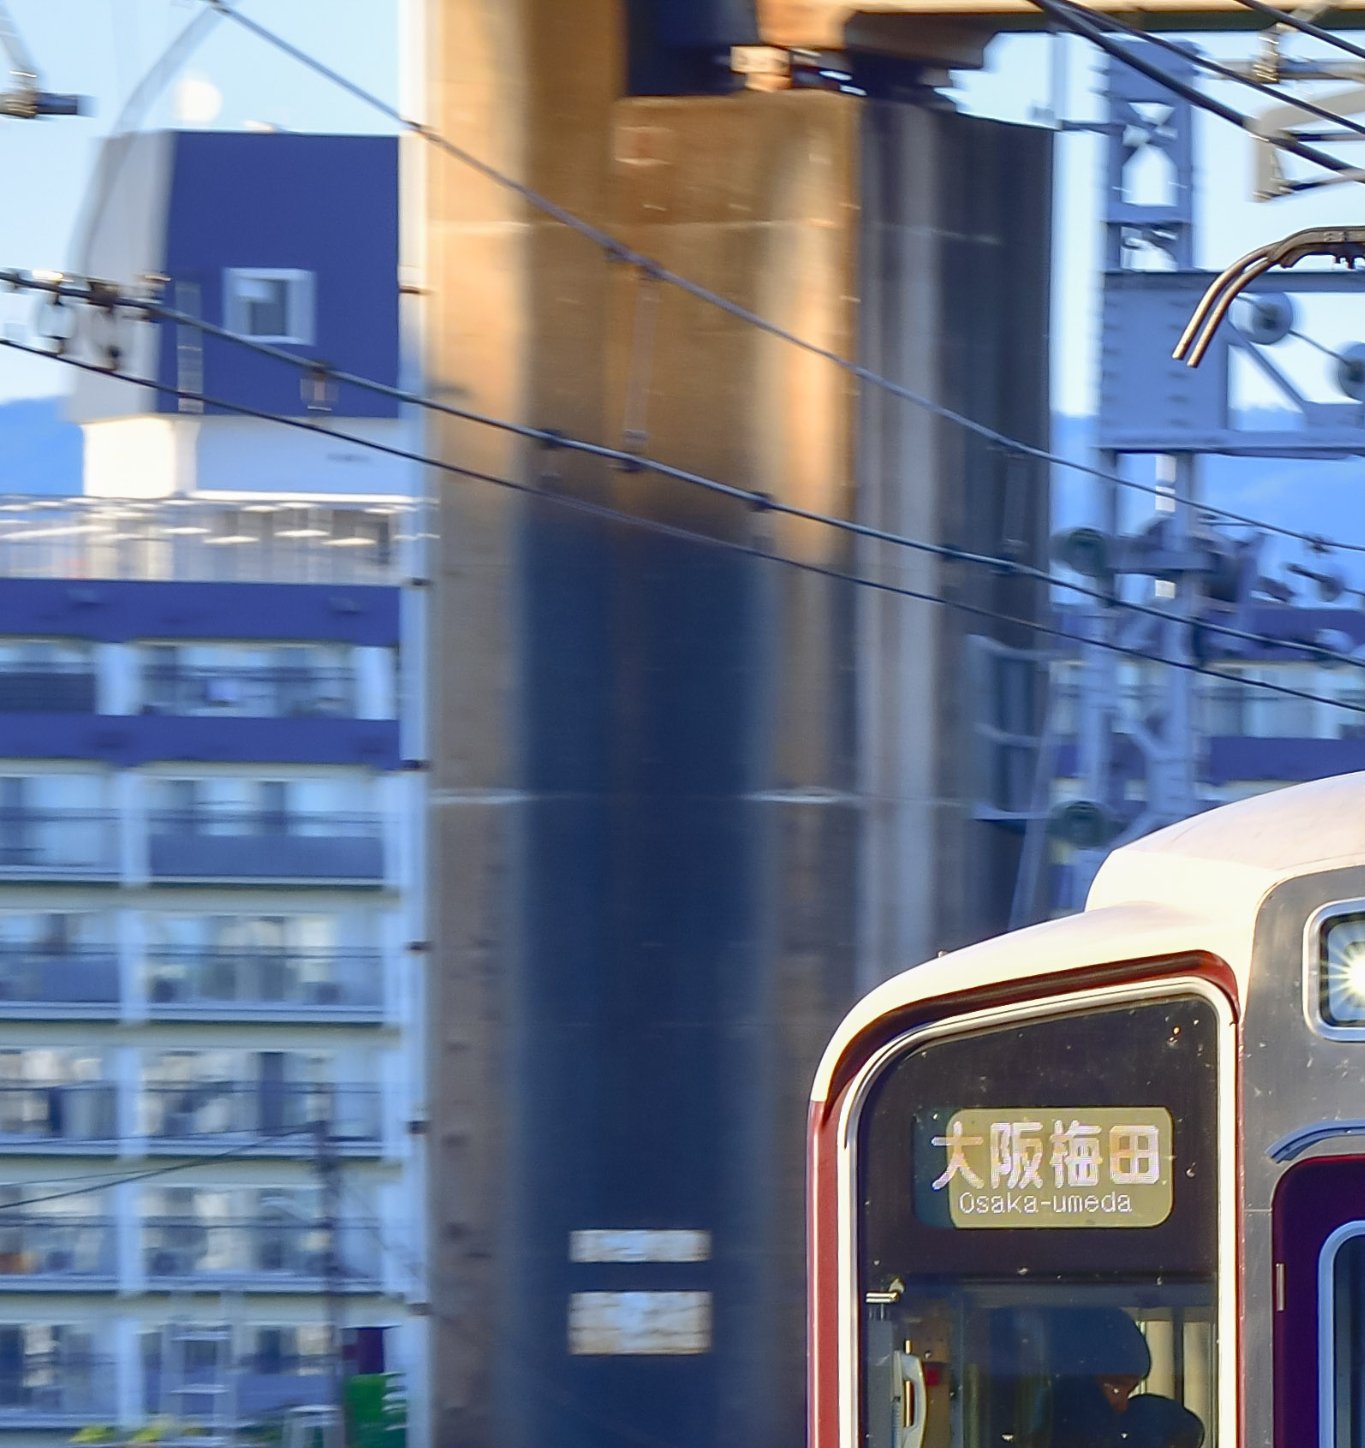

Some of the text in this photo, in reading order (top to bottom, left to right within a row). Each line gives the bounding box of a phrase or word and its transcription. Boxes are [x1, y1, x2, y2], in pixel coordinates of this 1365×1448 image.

[931, 1119, 1160, 1190] 大阪梅田
[959, 1191, 1133, 1214] Osaka-umeda
